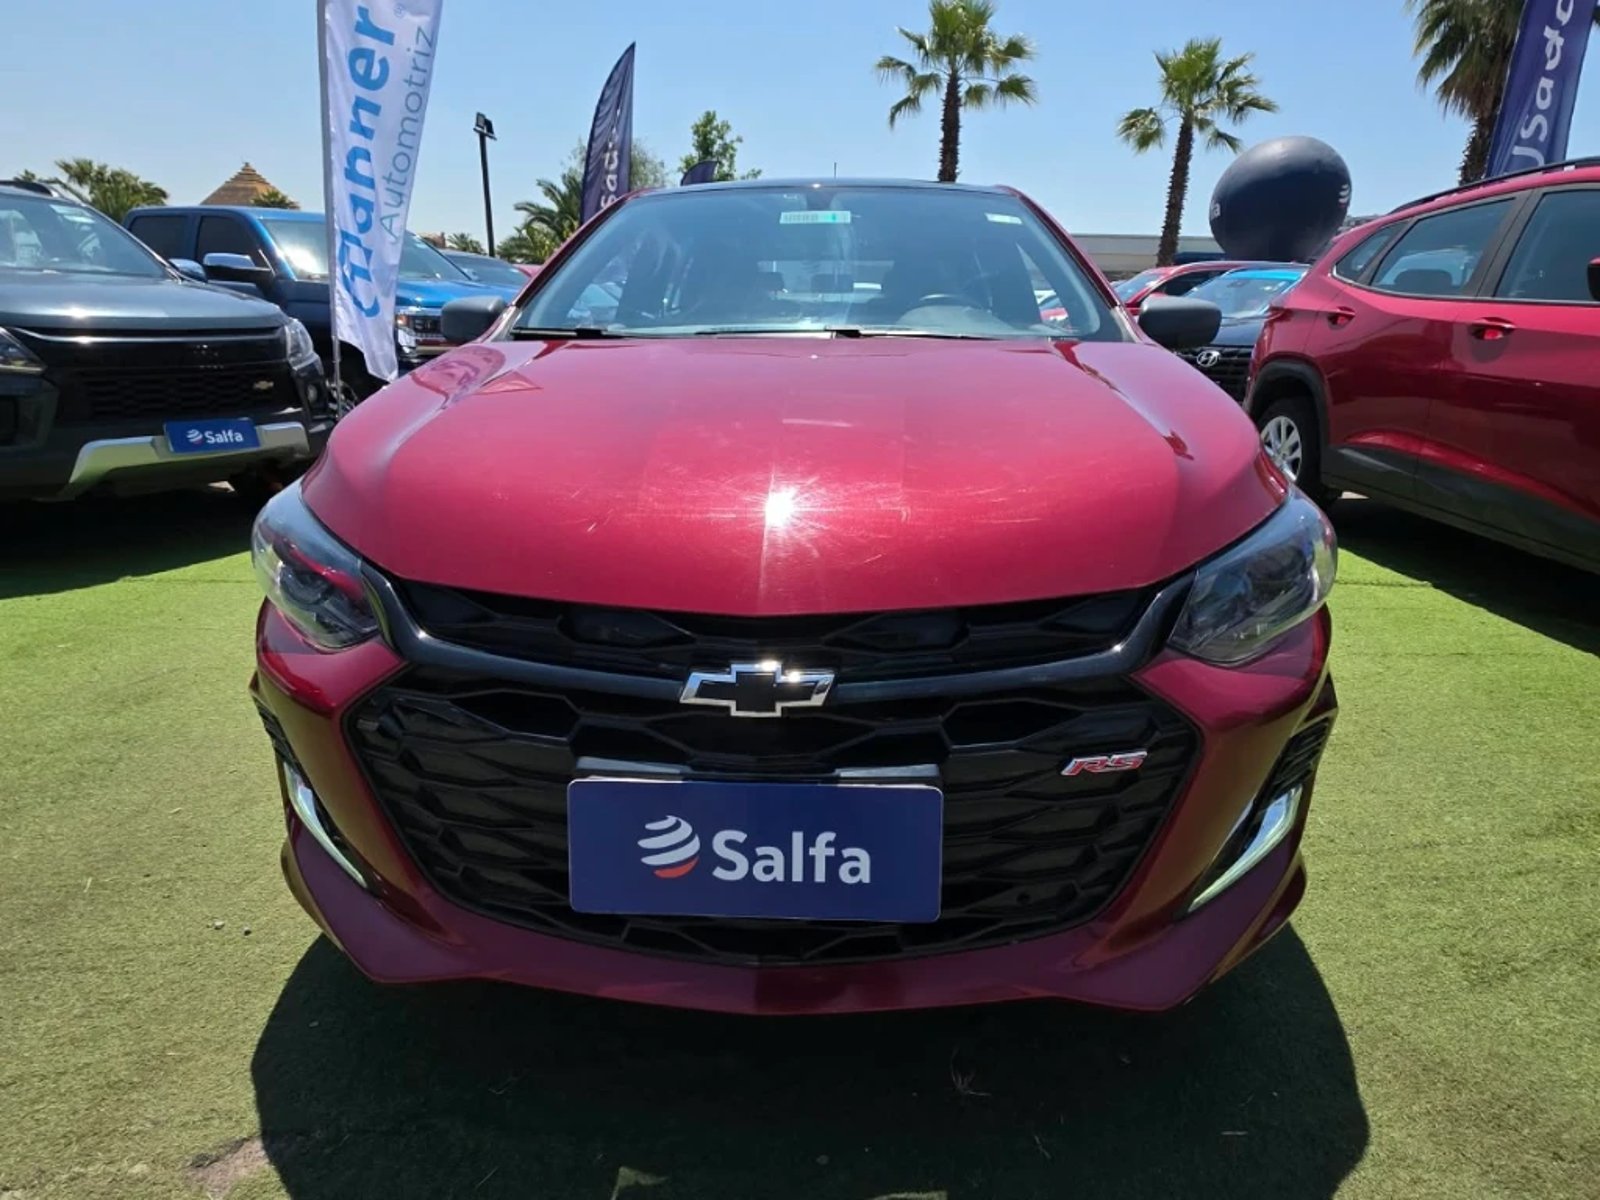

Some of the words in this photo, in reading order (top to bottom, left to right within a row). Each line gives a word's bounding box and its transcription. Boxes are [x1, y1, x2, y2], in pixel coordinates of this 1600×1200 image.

[380, 25, 435, 245] Automotriz
[204, 429, 244, 444] Salfa
[1061, 751, 1148, 776] RS
[711, 829, 872, 884] Salfa
